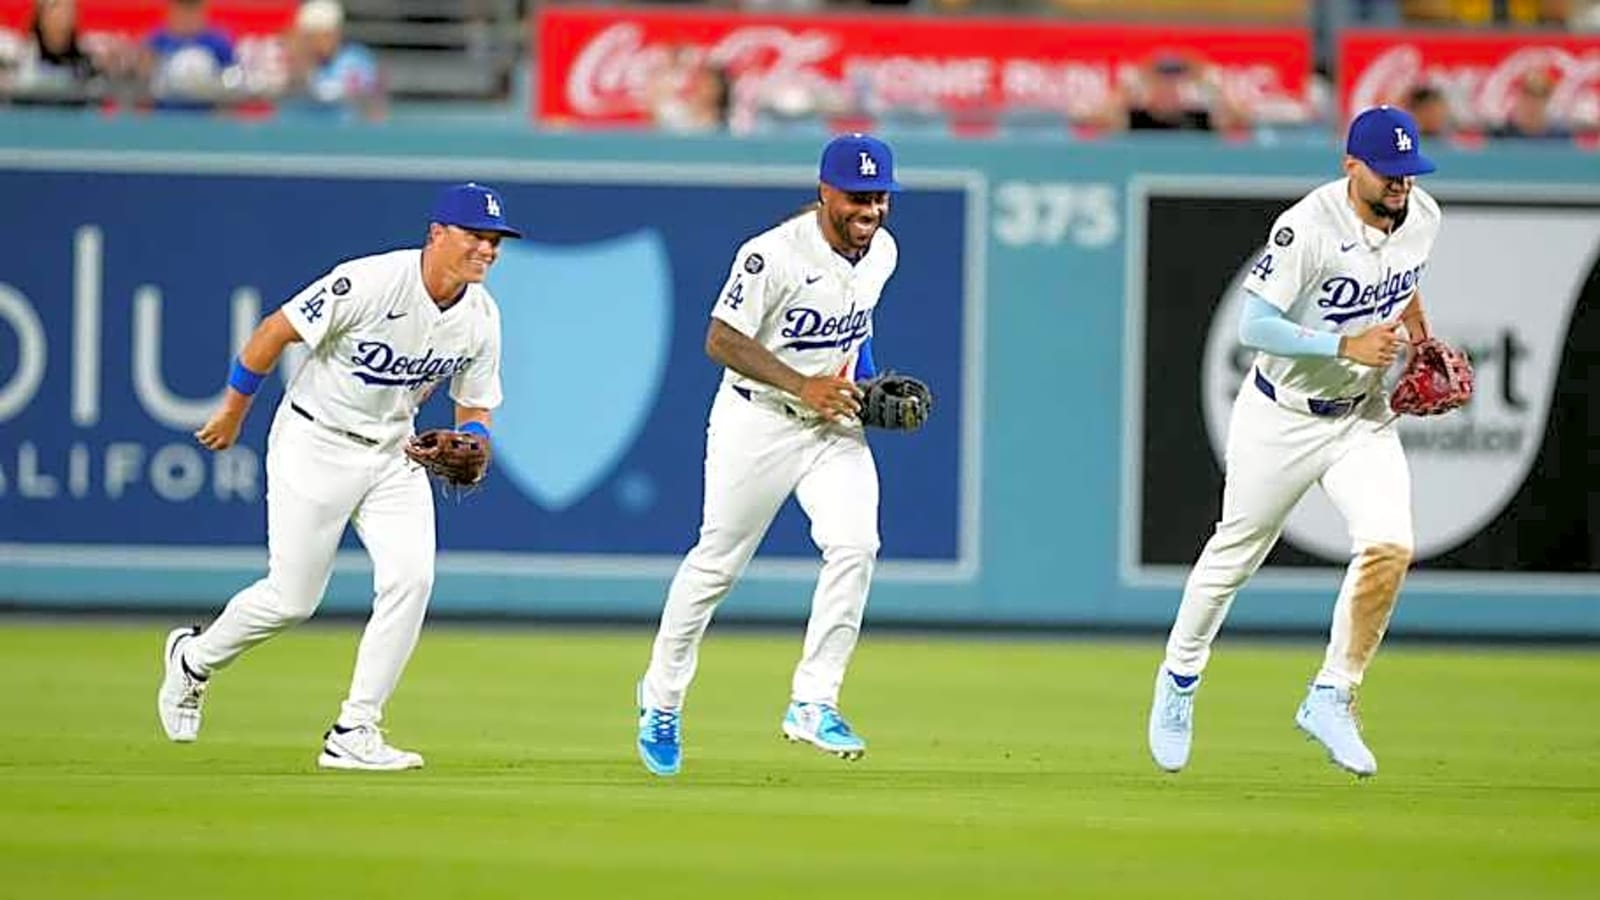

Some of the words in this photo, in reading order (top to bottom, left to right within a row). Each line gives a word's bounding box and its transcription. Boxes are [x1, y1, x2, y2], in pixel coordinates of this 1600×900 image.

[1394, 127, 1412, 151] LA
[859, 152, 877, 175] LA
[485, 194, 500, 216] LA
[993, 181, 1119, 247] 375
[300, 287, 327, 323] LA
[1317, 266, 1425, 324] Dodger
[0, 441, 259, 501] LIFOR
